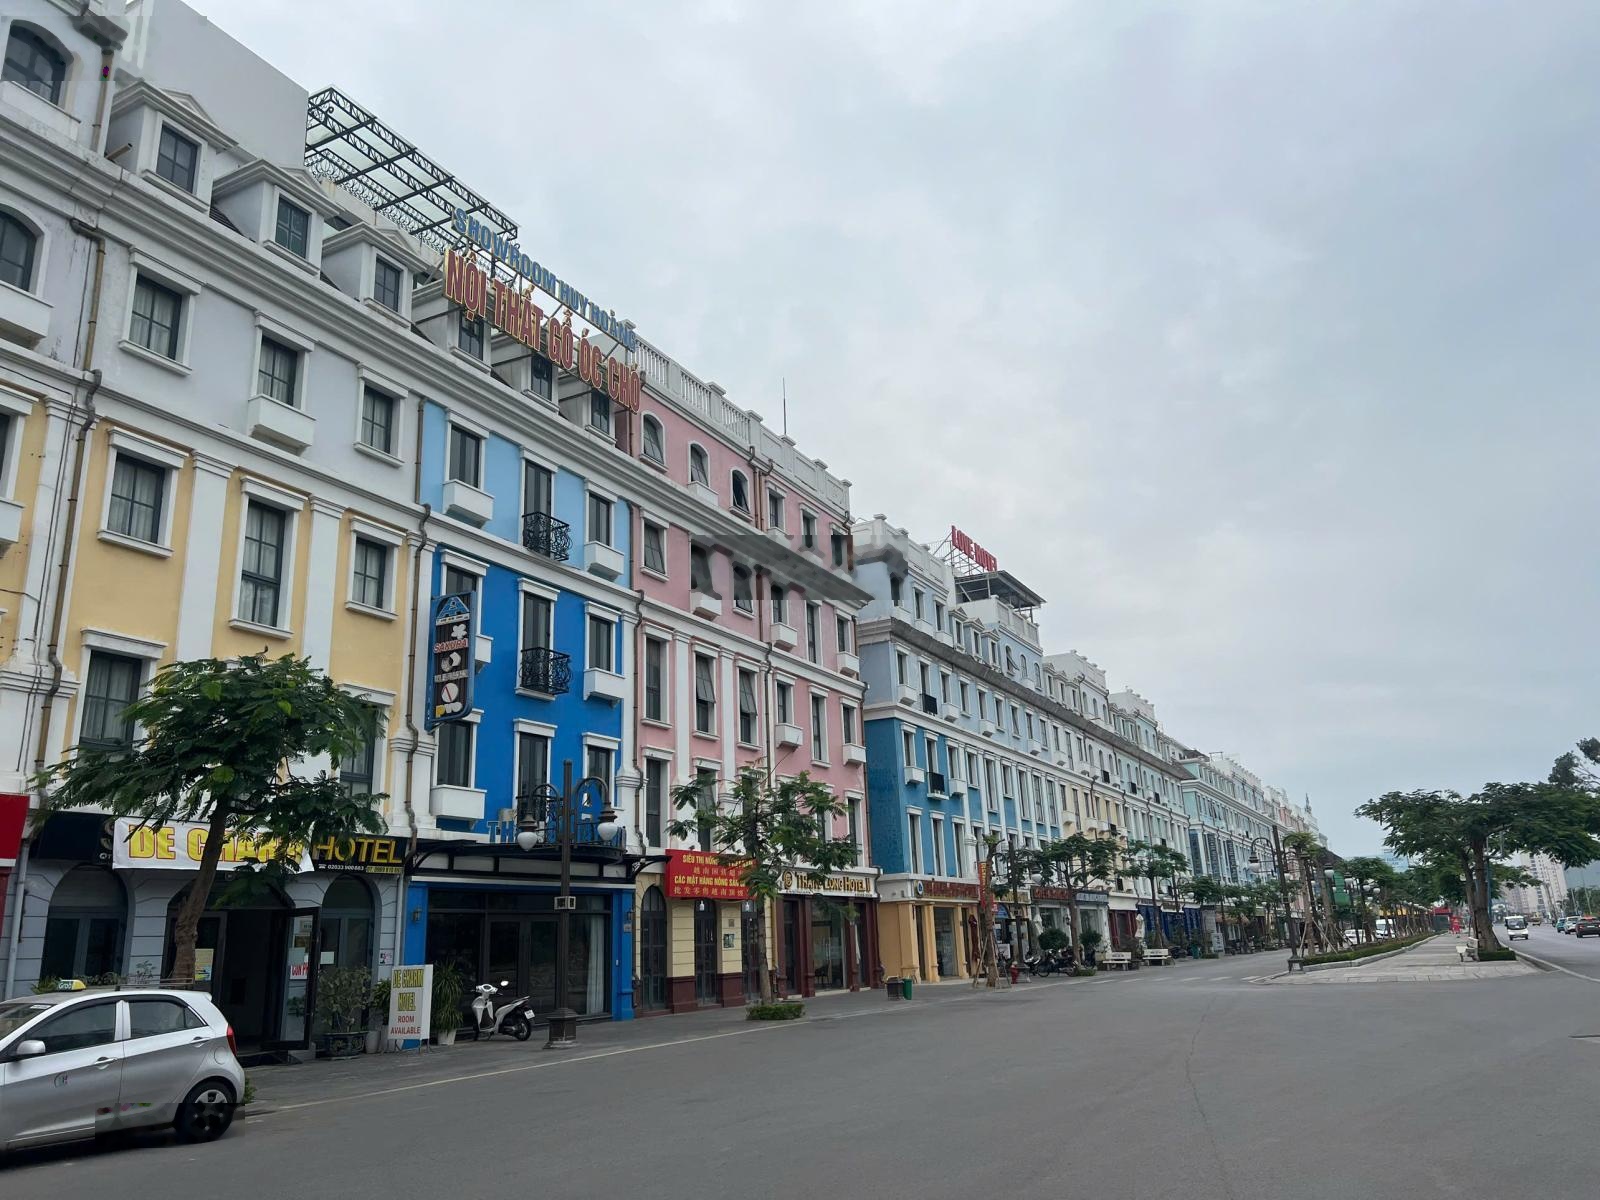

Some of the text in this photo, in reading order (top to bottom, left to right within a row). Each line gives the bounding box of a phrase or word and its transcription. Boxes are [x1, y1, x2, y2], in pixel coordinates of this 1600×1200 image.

[451, 207, 556, 297] SHOWROOM
[560, 280, 589, 319] HUY
[443, 246, 487, 321] NỘI
[491, 277, 544, 352] THẤT
[128, 824, 176, 860] DE
[312, 836, 402, 863] HOTEL
[58, 981, 73, 991] Grab
[393, 969, 424, 988] DE CHARM
[398, 992, 416, 1011] HOTEL
[398, 1015, 414, 1023] ROOM
[390, 1026, 421, 1035] AVAILABLE
